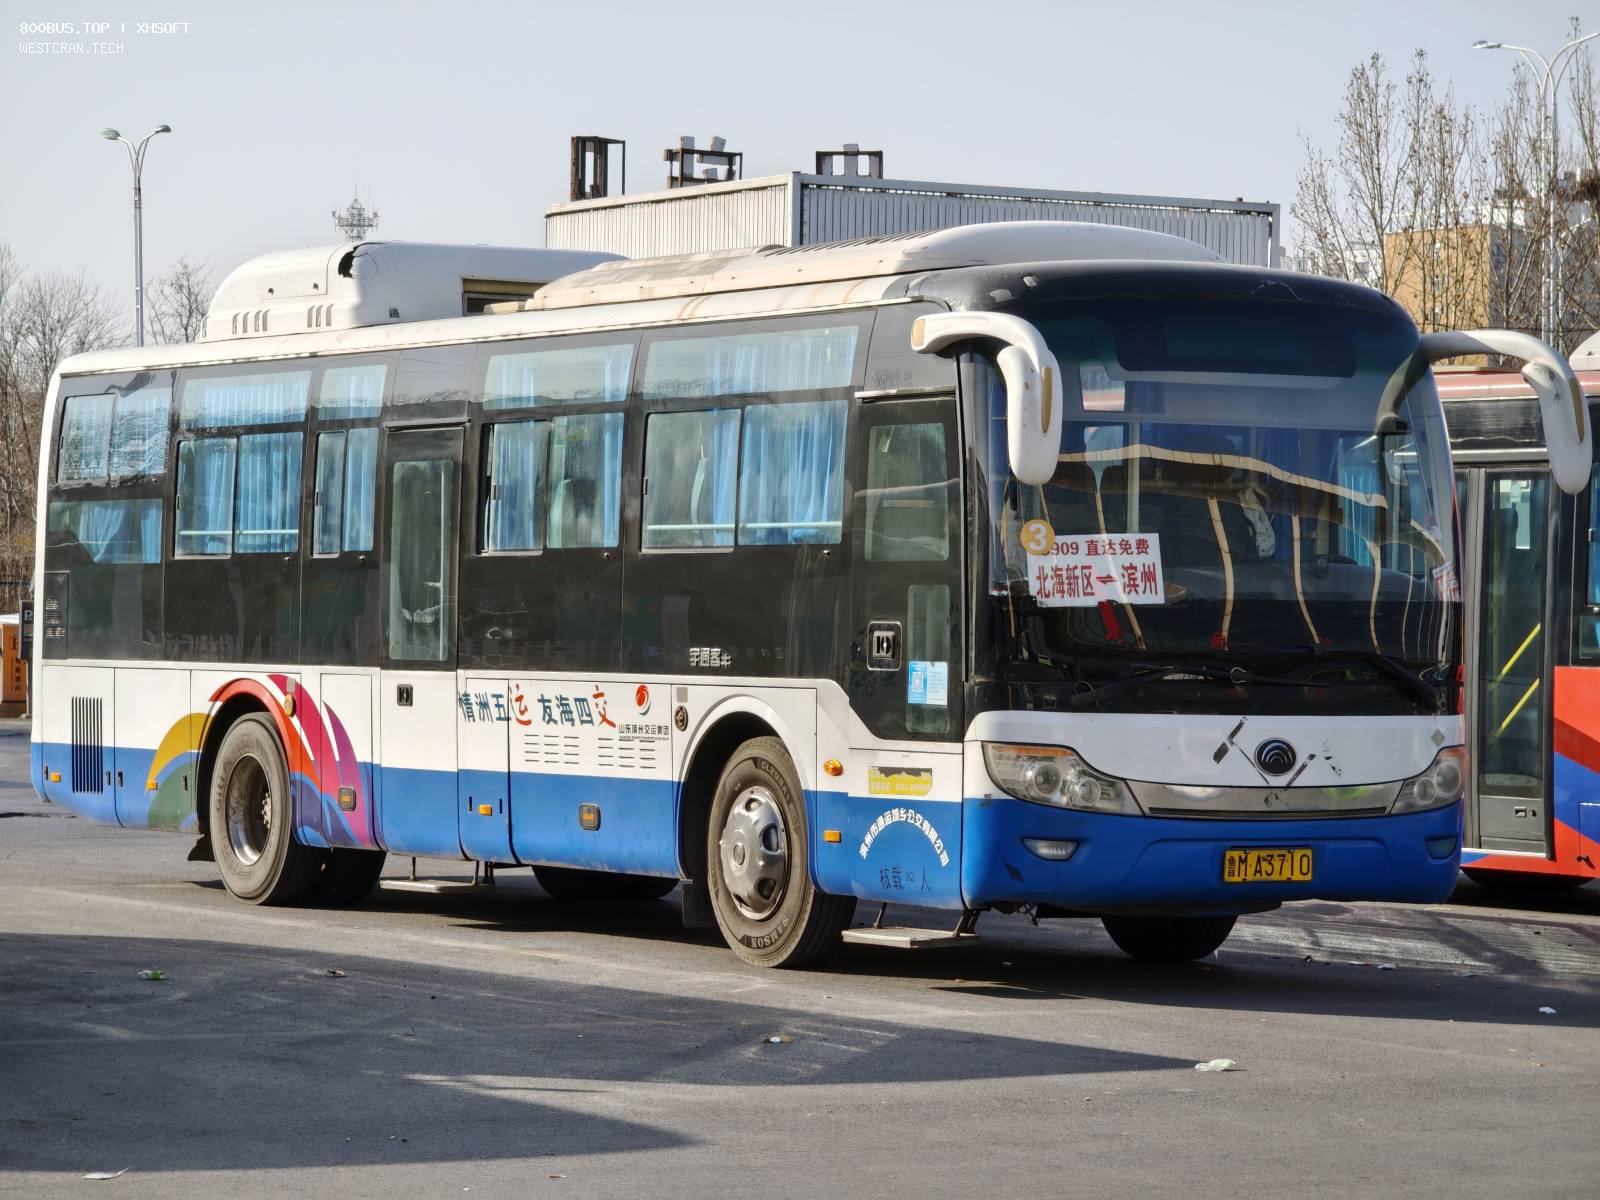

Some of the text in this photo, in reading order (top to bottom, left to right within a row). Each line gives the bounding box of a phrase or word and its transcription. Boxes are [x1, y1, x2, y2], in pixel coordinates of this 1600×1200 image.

[1028, 523, 1047, 550] 3
[1085, 538, 1150, 556] 直达免费
[1036, 562, 1158, 599] 北海新区 滨州
[751, 915, 789, 949] SAMSON
